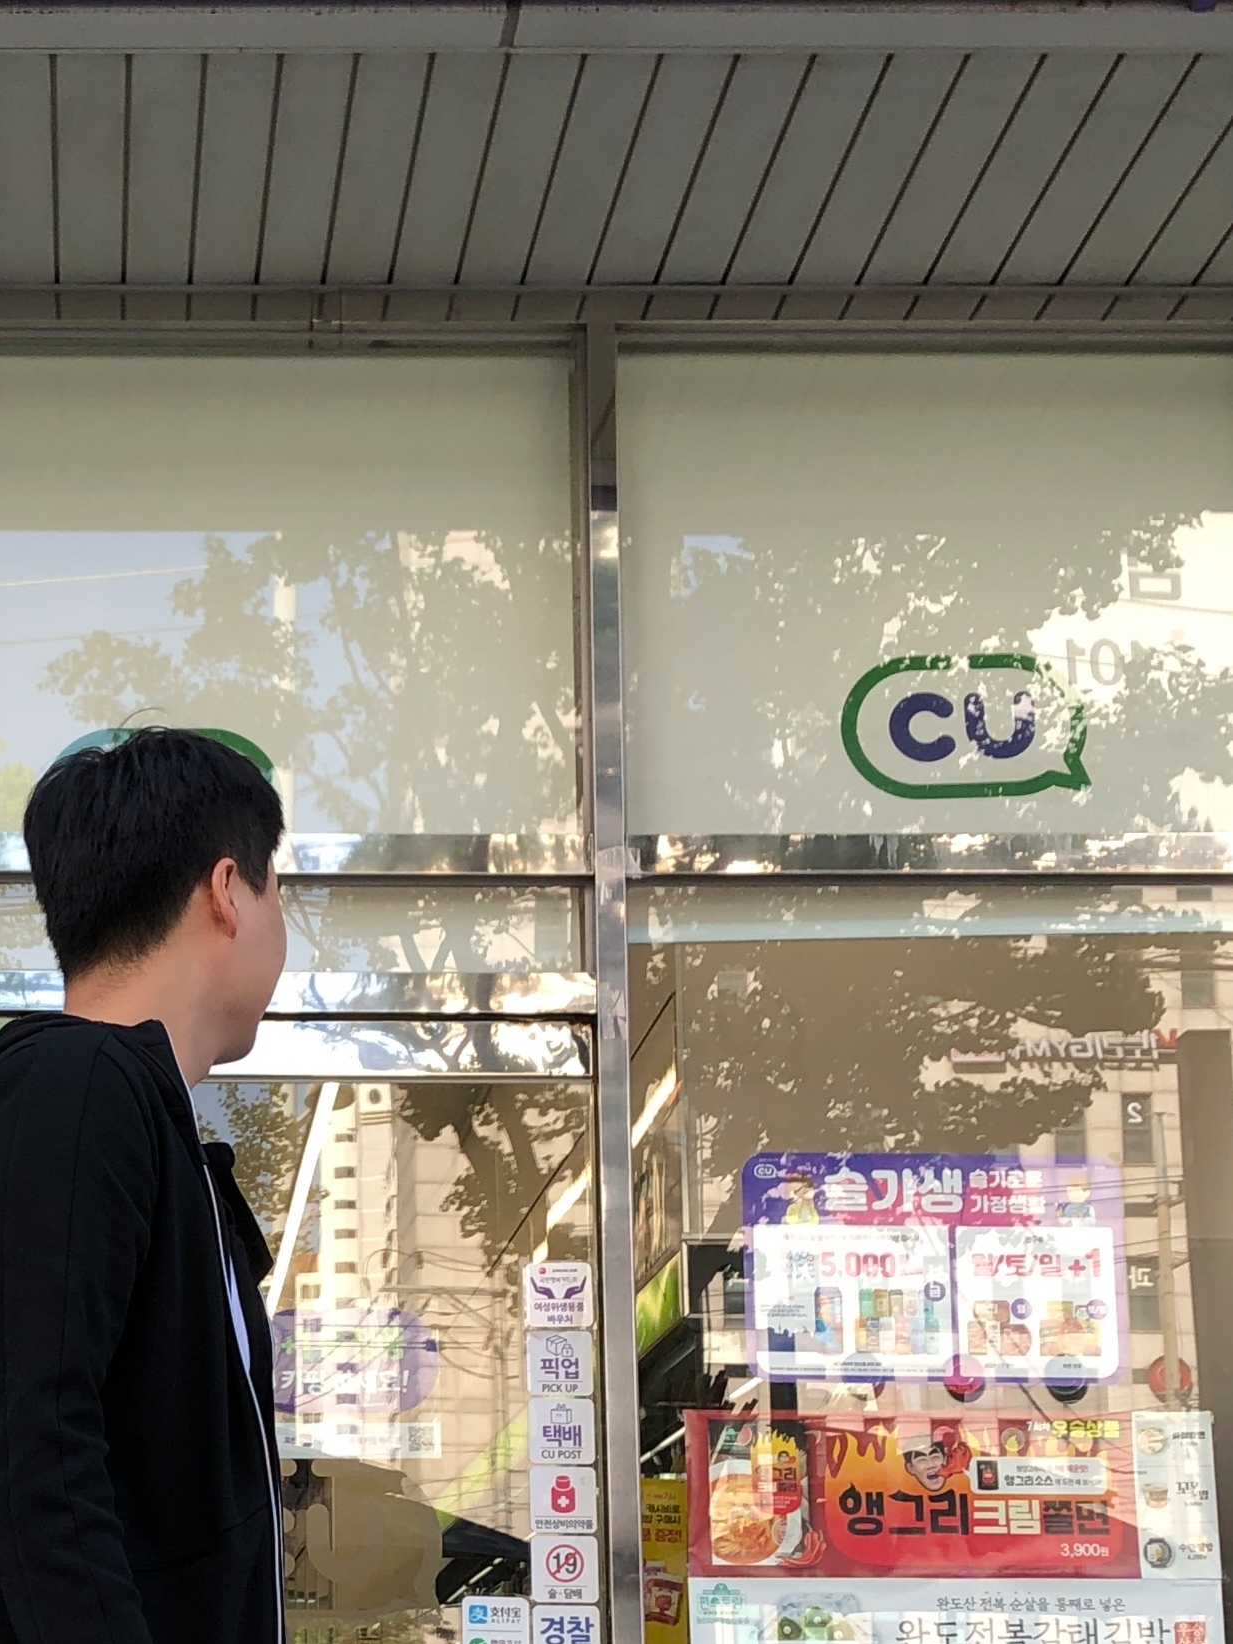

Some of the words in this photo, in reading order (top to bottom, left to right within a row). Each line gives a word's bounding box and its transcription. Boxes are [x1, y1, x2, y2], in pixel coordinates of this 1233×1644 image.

[889, 692, 1035, 761] CU
[823, 1167, 963, 1213] 슬기생
[970, 1194, 1046, 1214] 가정생활
[547, 1315, 573, 1324] 바우처
[540, 1358, 579, 1380] 픽업
[542, 1384, 562, 1393] PICK
[565, 1384, 578, 1393] UP
[542, 1425, 582, 1447] 택배
[1053, 1420, 1120, 1438] 우승상품
[541, 1450, 555, 1459] CU
[558, 1450, 582, 1459] POST
[535, 1520, 593, 1530] 안전상비의약품
[1060, 1543, 1109, 1557] 3,900원
[552, 1552, 577, 1574] 19
[937, 1597, 975, 1611] 완도산
[980, 1597, 1005, 1611] 전복
[1009, 1597, 1049, 1611] 순살을
[1055, 1597, 1095, 1611] 통째로
[1099, 1597, 1125, 1611] 넣은
